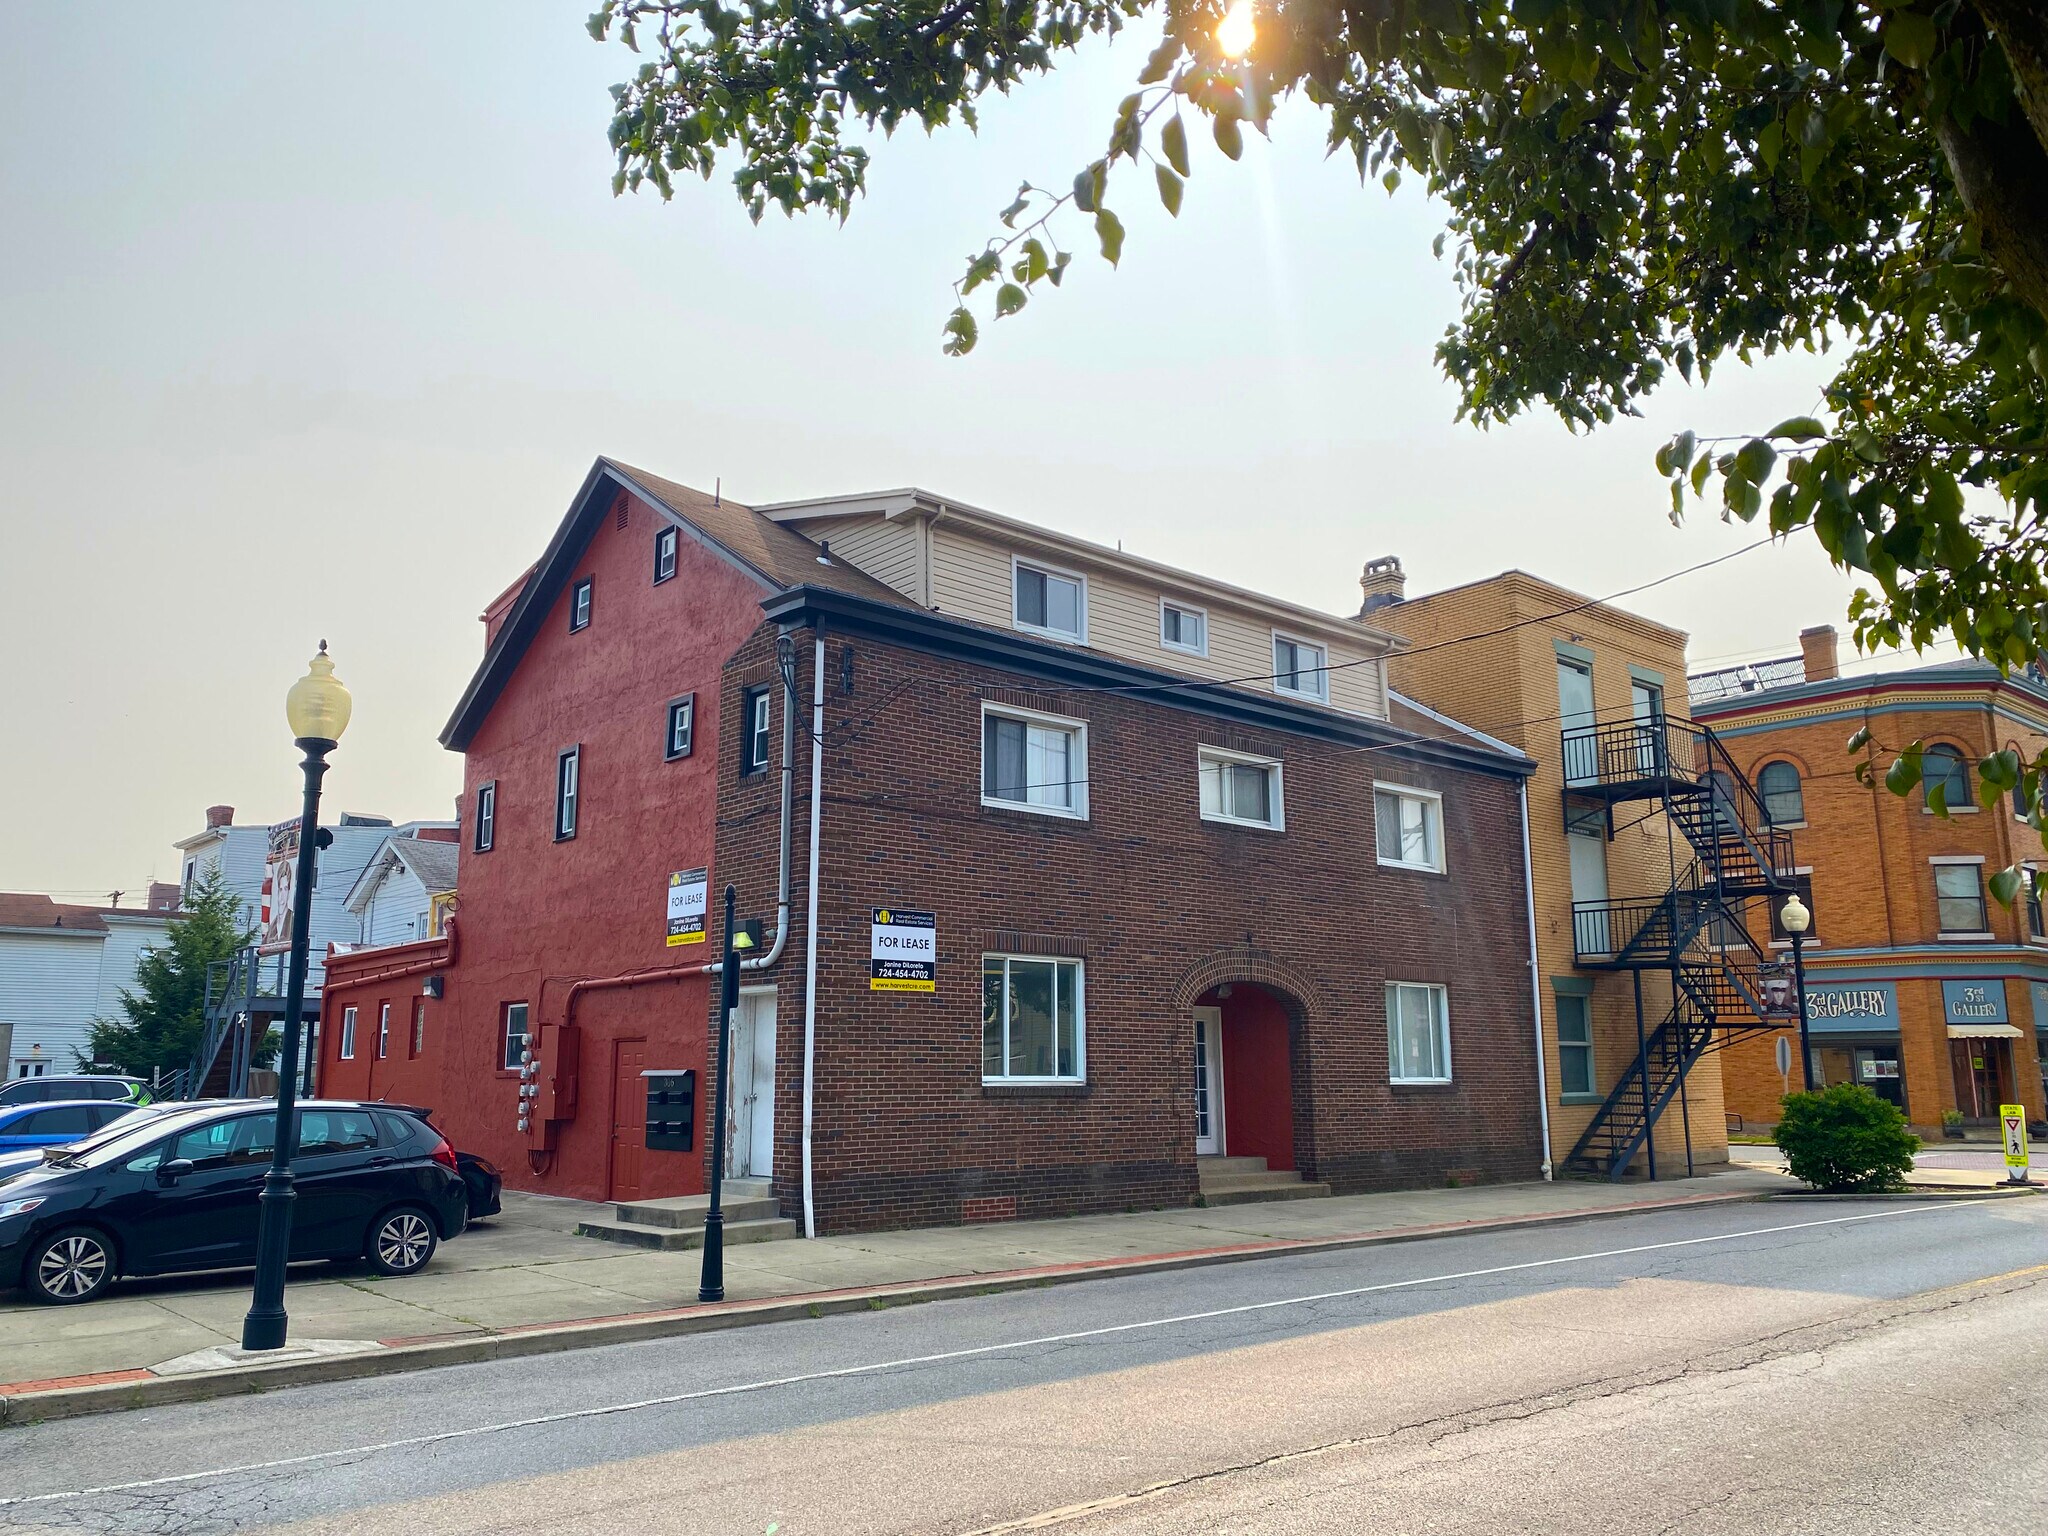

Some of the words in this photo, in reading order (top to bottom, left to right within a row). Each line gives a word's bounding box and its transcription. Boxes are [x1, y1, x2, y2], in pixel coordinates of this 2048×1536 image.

[671, 896, 684, 907] FOR
[684, 893, 703, 905] LEASE
[670, 922, 702, 935] 724-454-4702
[878, 936, 899, 948] FOR
[901, 937, 930, 950] LEASE
[878, 968, 929, 979] 724-454-4702
[1964, 987, 1984, 1003] 3rd
[1827, 990, 1888, 1018] GALLERY
[1952, 999, 1999, 1017] GALLERY
